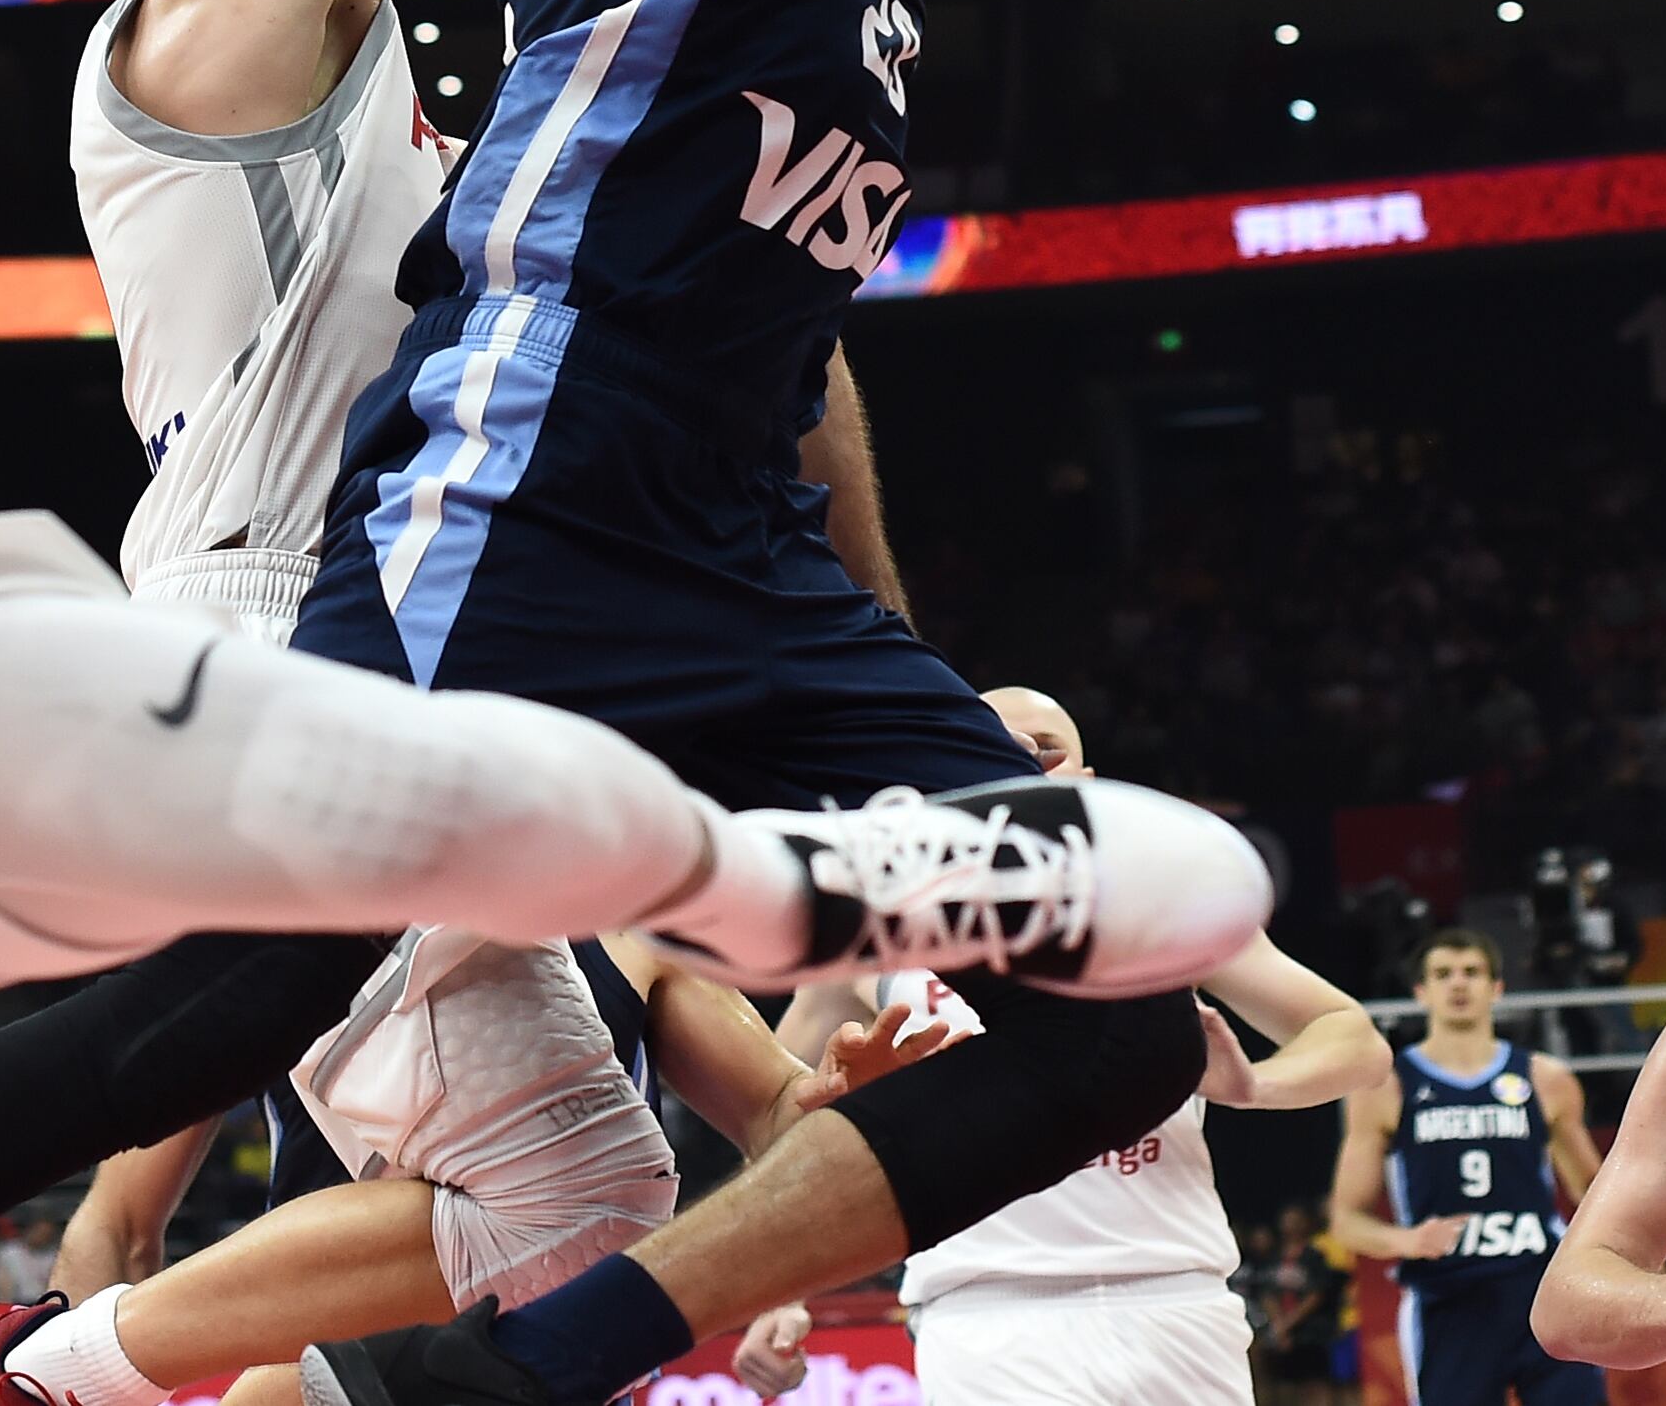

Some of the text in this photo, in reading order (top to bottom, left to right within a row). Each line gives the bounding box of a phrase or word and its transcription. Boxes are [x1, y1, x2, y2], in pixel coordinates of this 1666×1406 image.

[739, 90, 911, 280] VISA
[1459, 1149, 1492, 1198] 9
[1447, 1211, 1548, 1256] ISA
